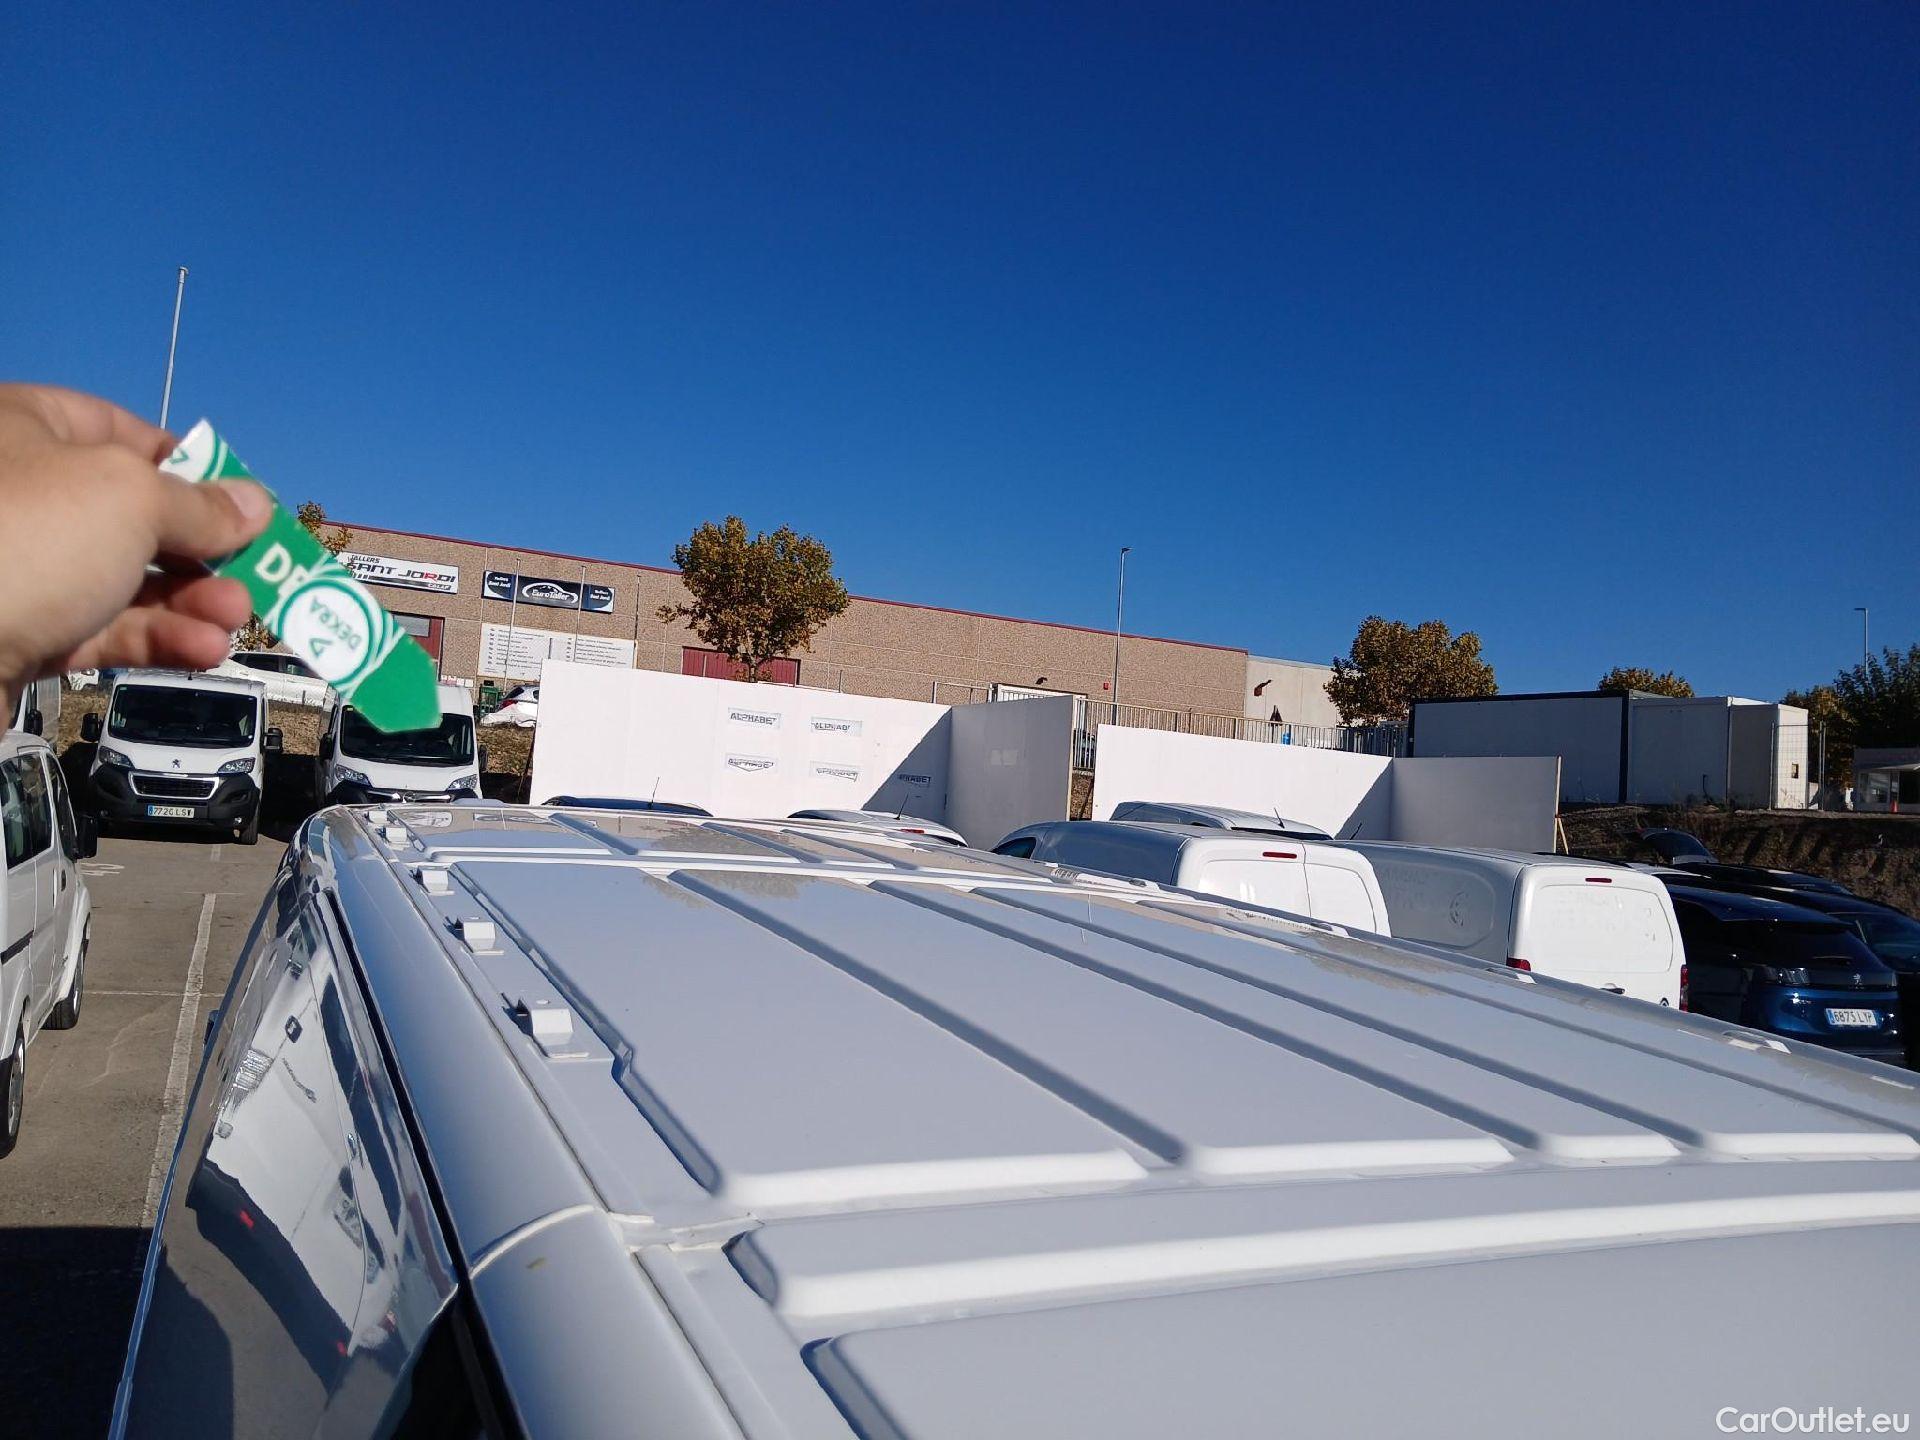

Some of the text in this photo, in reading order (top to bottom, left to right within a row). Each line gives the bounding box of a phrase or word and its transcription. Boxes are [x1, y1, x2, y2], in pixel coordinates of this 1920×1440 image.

[346, 562, 456, 583] SANT JORDI
[310, 595, 361, 651] DEKRA
